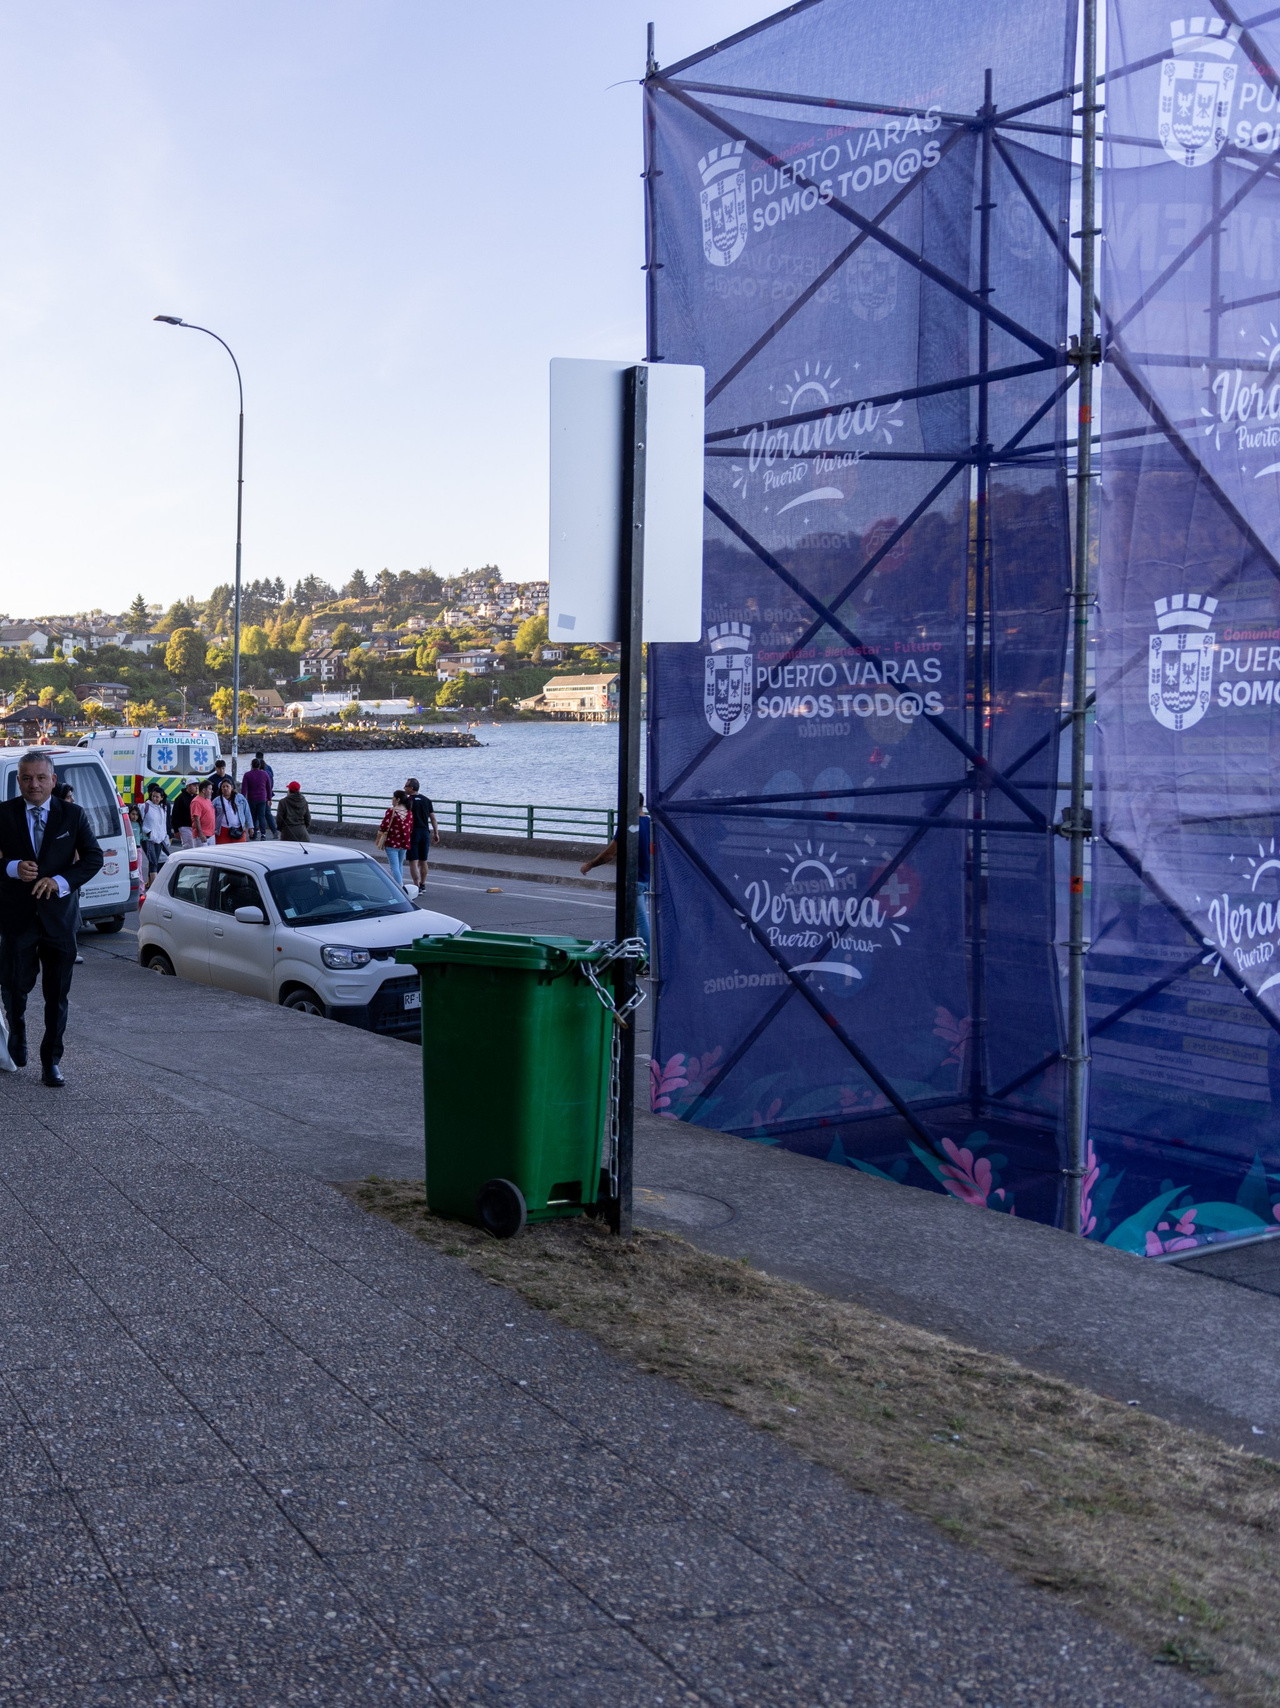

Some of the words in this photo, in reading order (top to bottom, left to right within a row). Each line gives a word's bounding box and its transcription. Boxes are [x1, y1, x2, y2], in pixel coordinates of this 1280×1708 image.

[751, 145, 841, 203] PUERTO
[844, 104, 943, 162] VARAS
[752, 179, 834, 233] SOMOS
[837, 140, 942, 199] TOD@S
[742, 400, 881, 473] Veranea
[762, 462, 808, 494] Puerto
[812, 449, 870, 475] Varas
[757, 648, 816, 662] Comunidad
[825, 643, 880, 659] Bienestar
[894, 641, 942, 654] Futuro
[757, 663, 837, 689] PUERTO
[841, 657, 943, 686] VARAS
[757, 693, 835, 720] SOMOS
[837, 691, 945, 724] TOD@S
[156, 737, 209, 745] AMBULANCIA
[744, 880, 887, 928] Veranea
[767, 926, 824, 949] Puerto
[826, 930, 882, 953] Varas
[1233, 942, 1274, 972] Puerto
